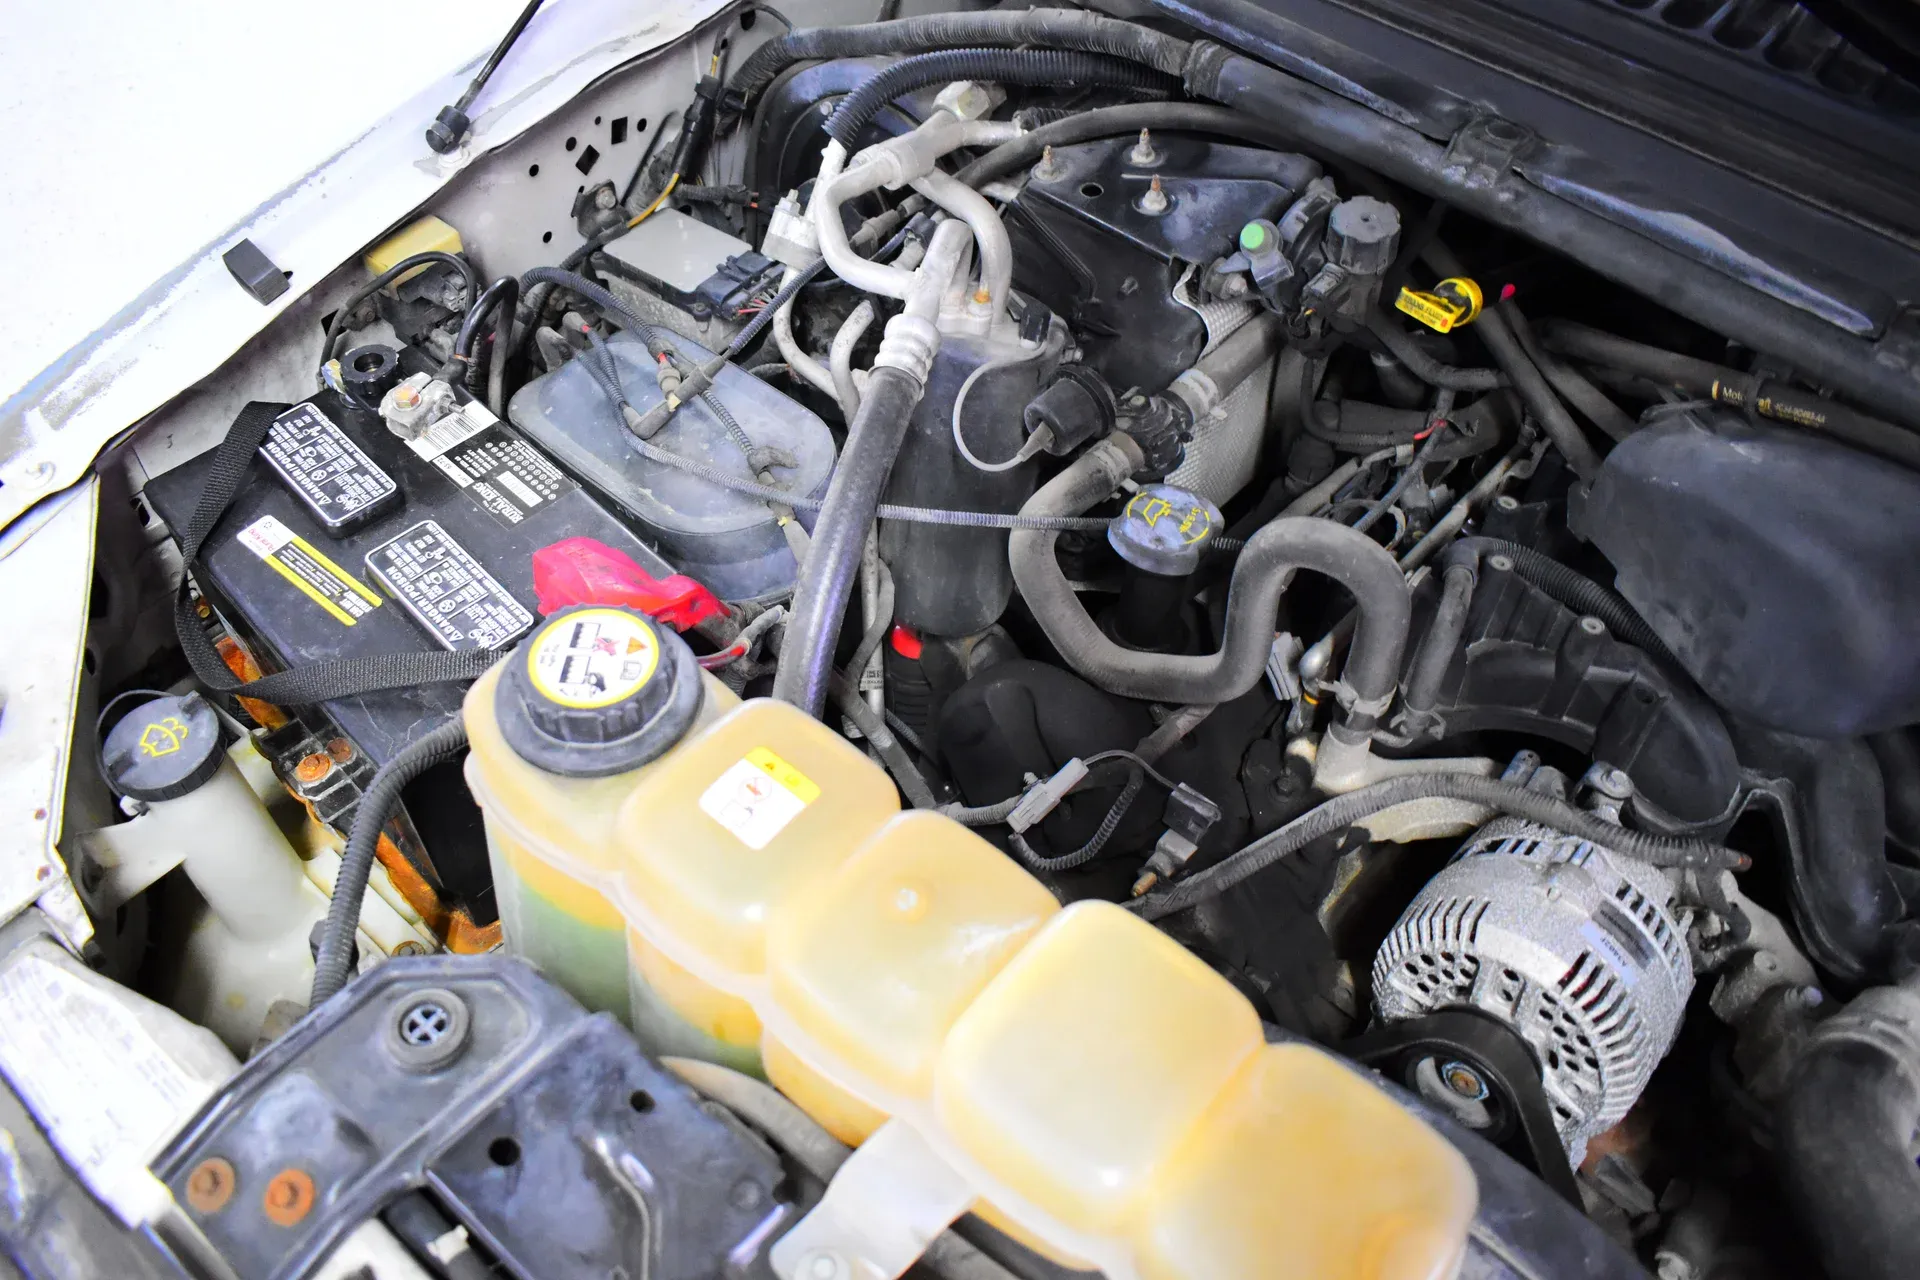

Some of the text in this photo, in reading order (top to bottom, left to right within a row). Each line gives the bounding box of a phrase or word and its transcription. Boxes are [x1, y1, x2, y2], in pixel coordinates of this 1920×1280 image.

[265, 440, 325, 499] DANGER/POISON
[470, 480, 498, 501] KING
[489, 496, 525, 523] RURAL
[384, 565, 457, 634] DANGER/POISON
